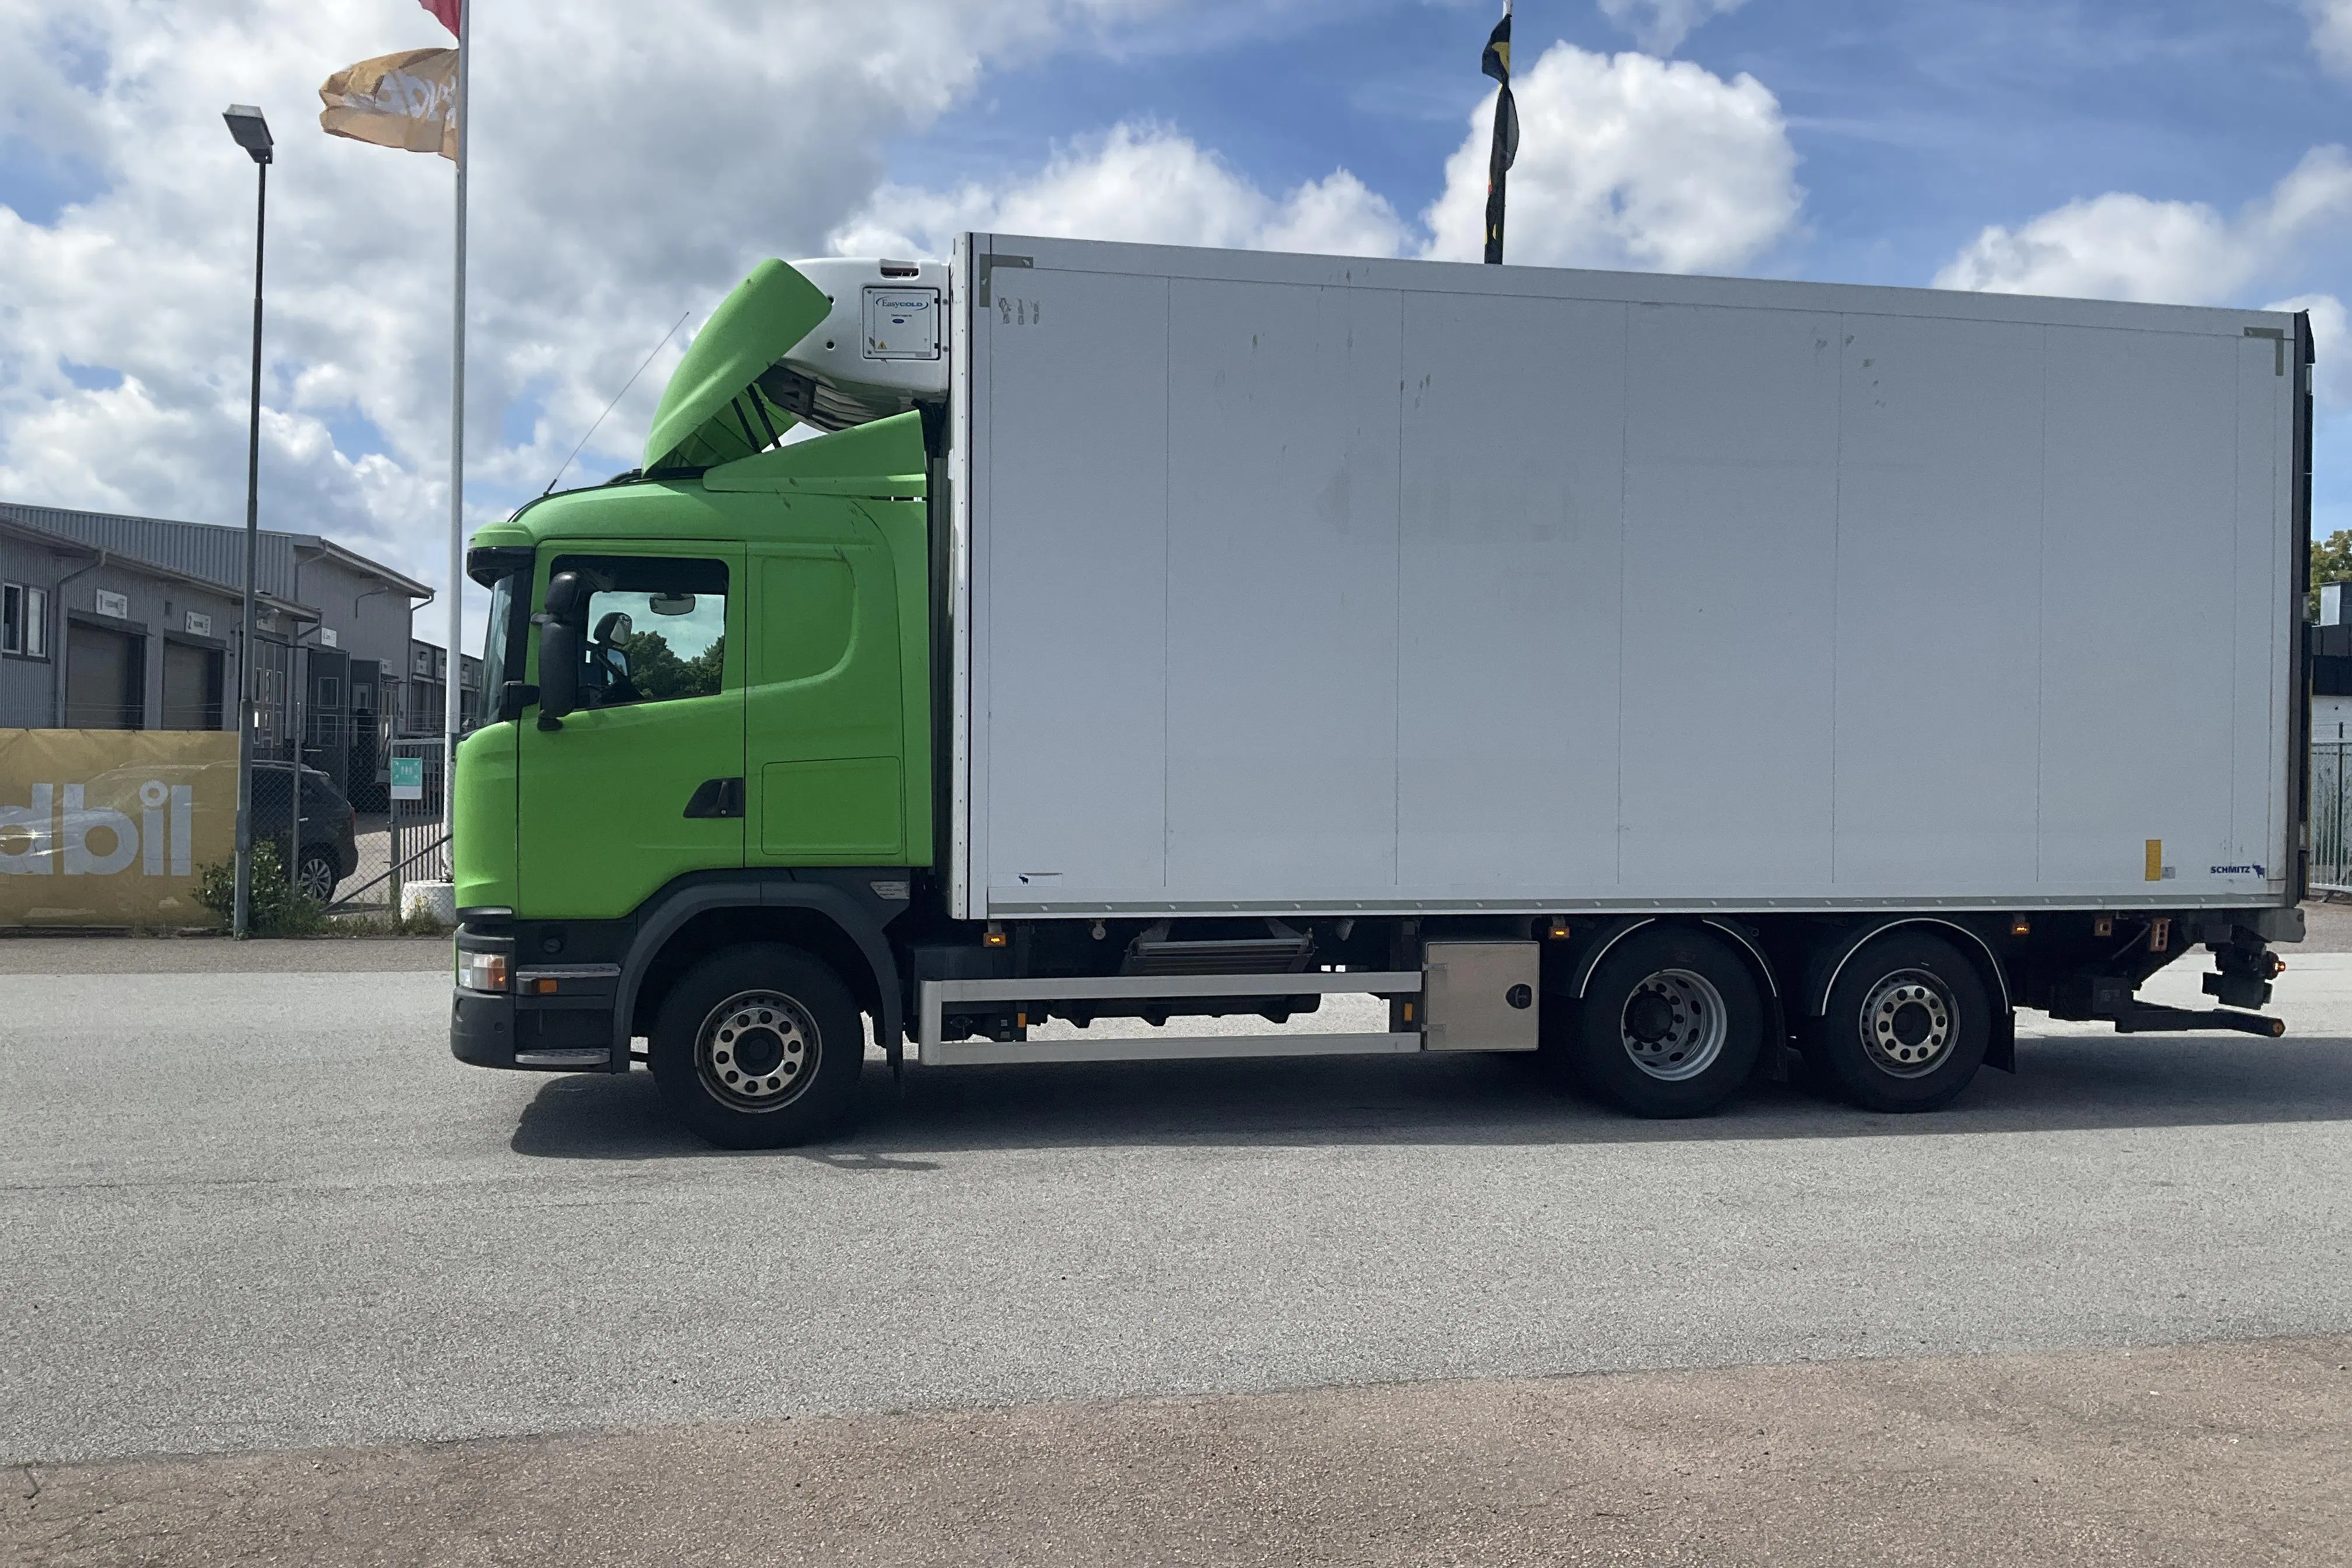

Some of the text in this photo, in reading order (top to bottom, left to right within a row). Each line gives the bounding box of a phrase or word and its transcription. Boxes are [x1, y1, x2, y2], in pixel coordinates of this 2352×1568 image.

[188, 615, 192, 629] 2
[0, 779, 192, 875] dbil
[2210, 866, 2250, 874] SCHMITZ
